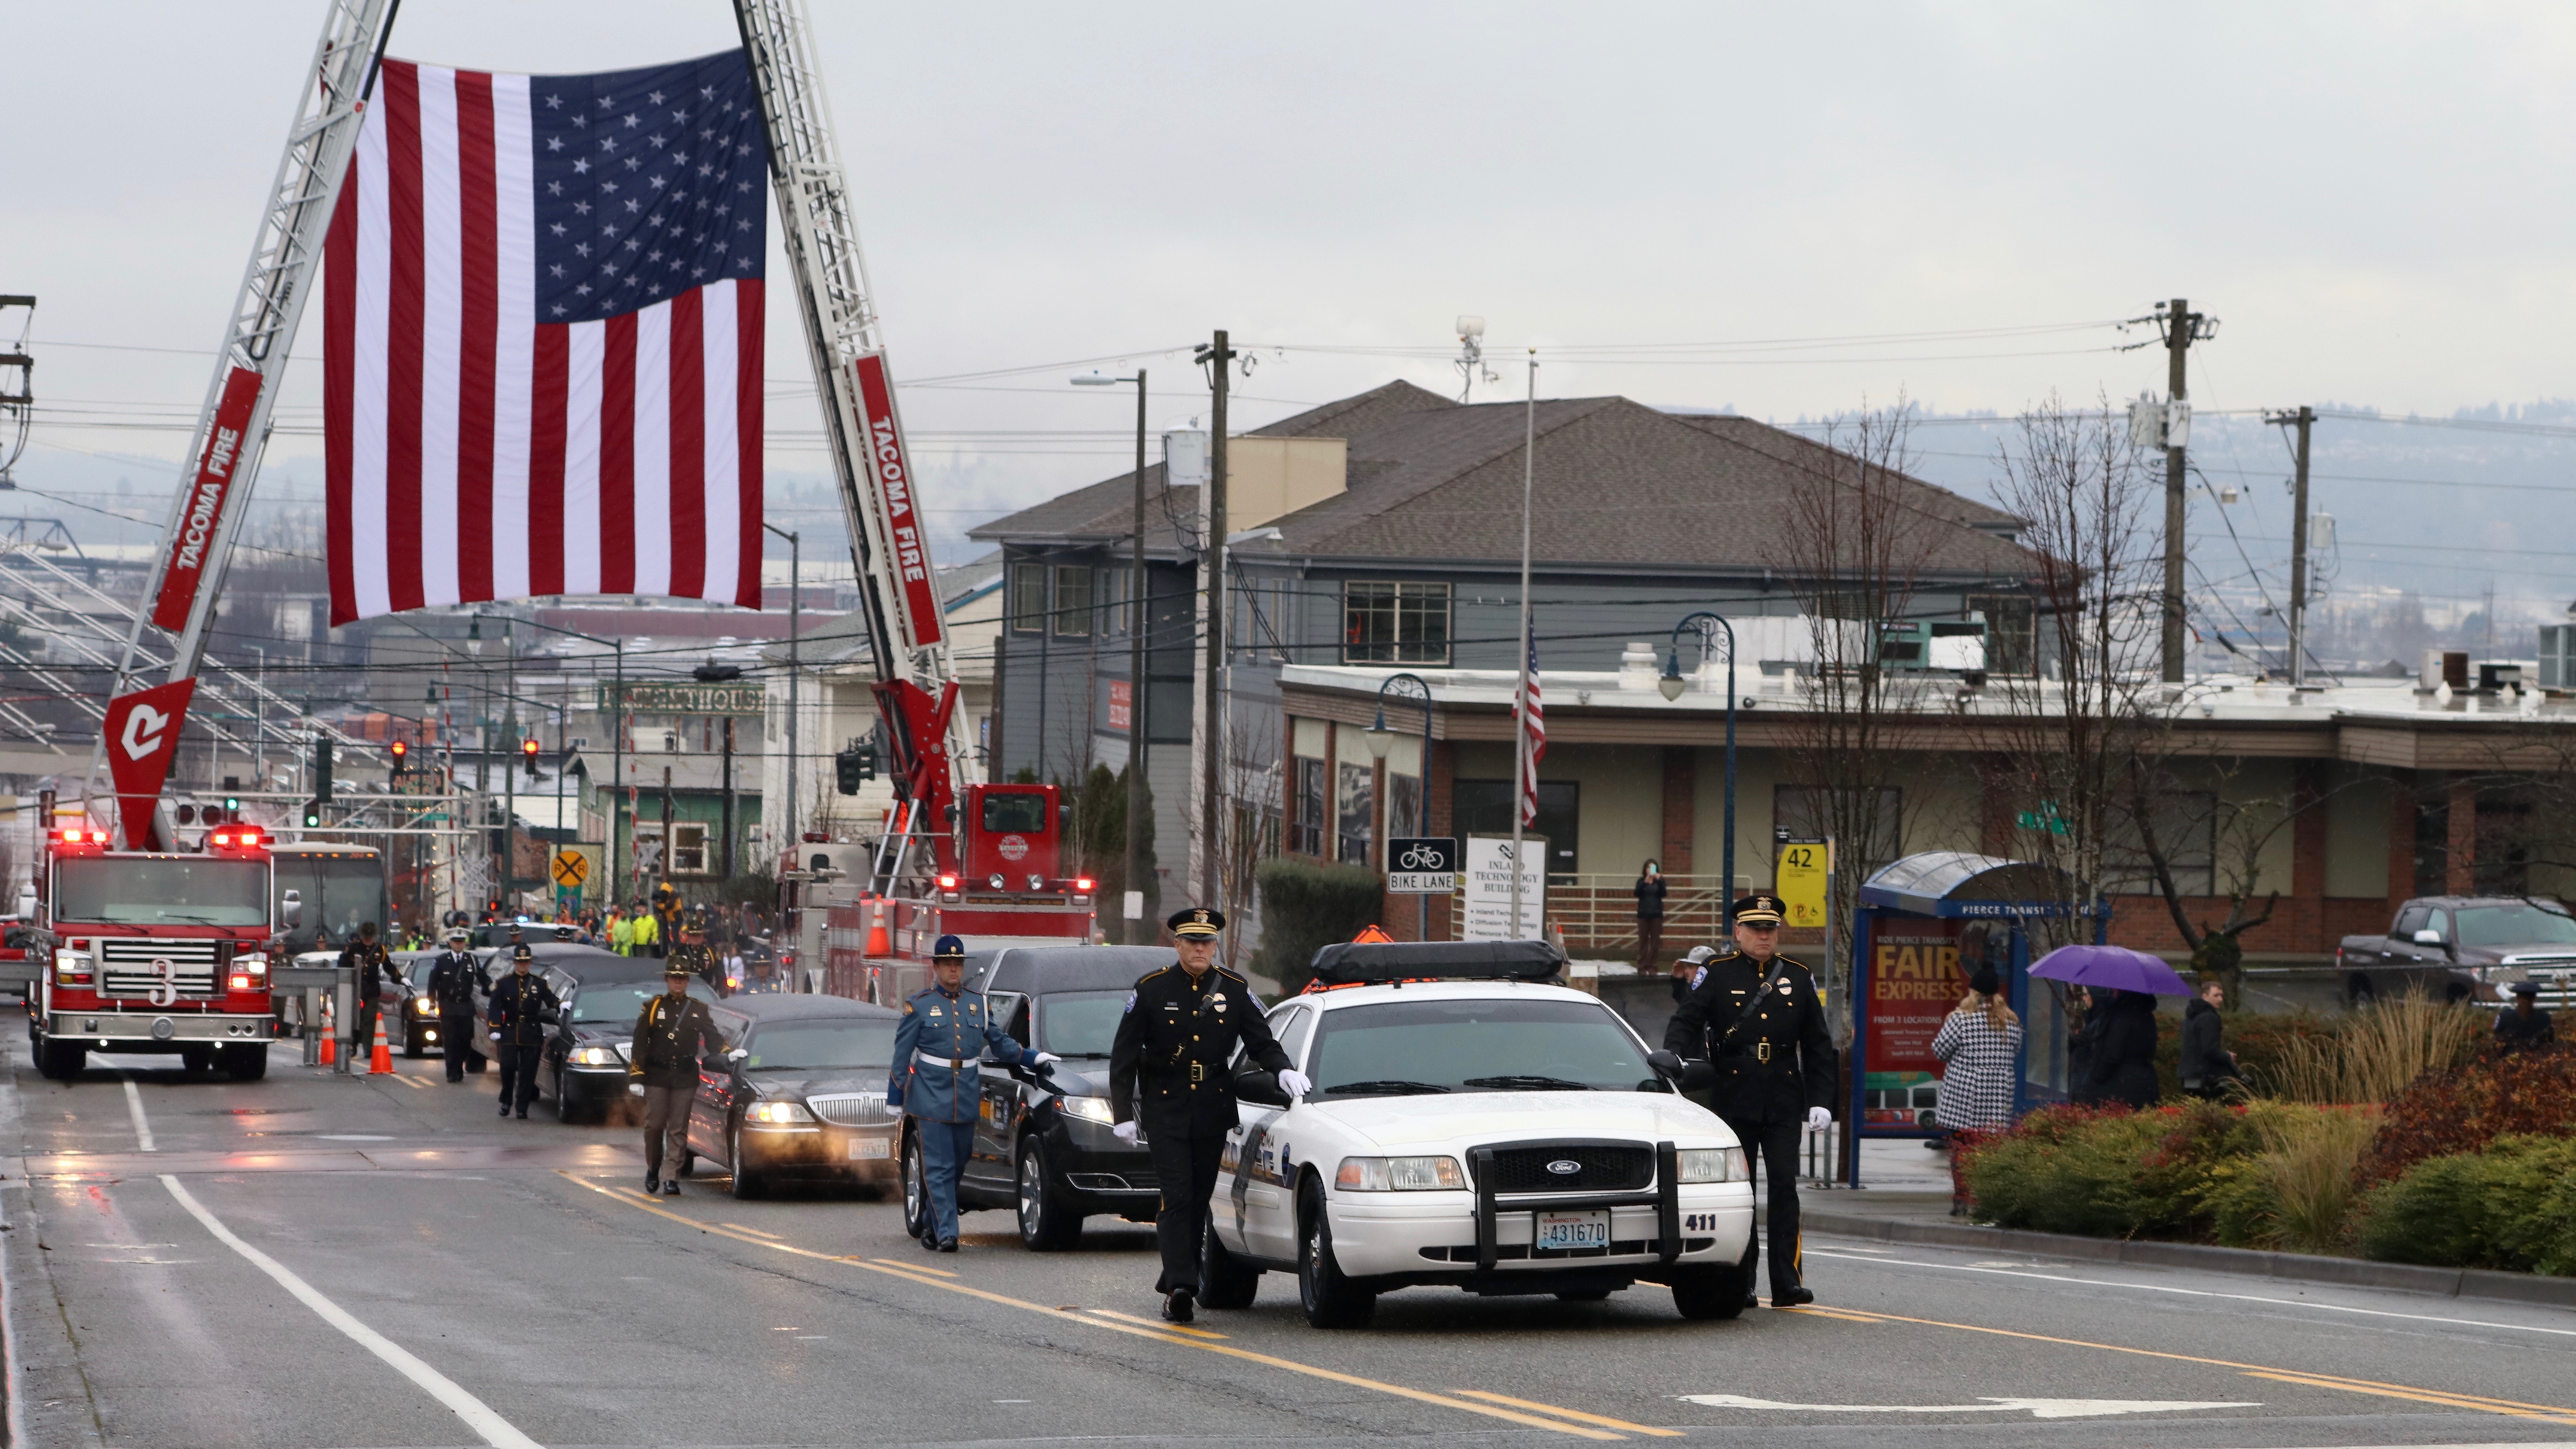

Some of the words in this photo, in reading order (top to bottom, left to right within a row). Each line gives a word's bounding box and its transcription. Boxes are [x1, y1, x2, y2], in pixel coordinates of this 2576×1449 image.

[177, 482, 222, 570] TACOMA
[207, 425, 239, 477] FIRE
[873, 416, 909, 517] TACOMA
[896, 526, 924, 582] FIRE
[1489, 860, 1525, 871] INLAD
[1788, 849, 1811, 867] 42
[554, 864, 562, 872] R
[578, 865, 585, 873] R
[1391, 876, 1417, 887] BIKE
[1424, 876, 1452, 887] LANE
[1475, 872, 1538, 883] TECHNOOGY
[1485, 883, 1530, 894] BUILDNG
[1962, 905, 2000, 914] PIERCE
[2005, 905, 2051, 915] TRANSI
[1877, 945, 1960, 979] FAIR
[148, 958, 176, 1007] 3
[1875, 981, 1964, 1000] EXPRESS
[1555, 1163, 1573, 1171] Ford
[1686, 1214, 1715, 1231] 411
[1550, 1224, 1604, 1242] 43167D
